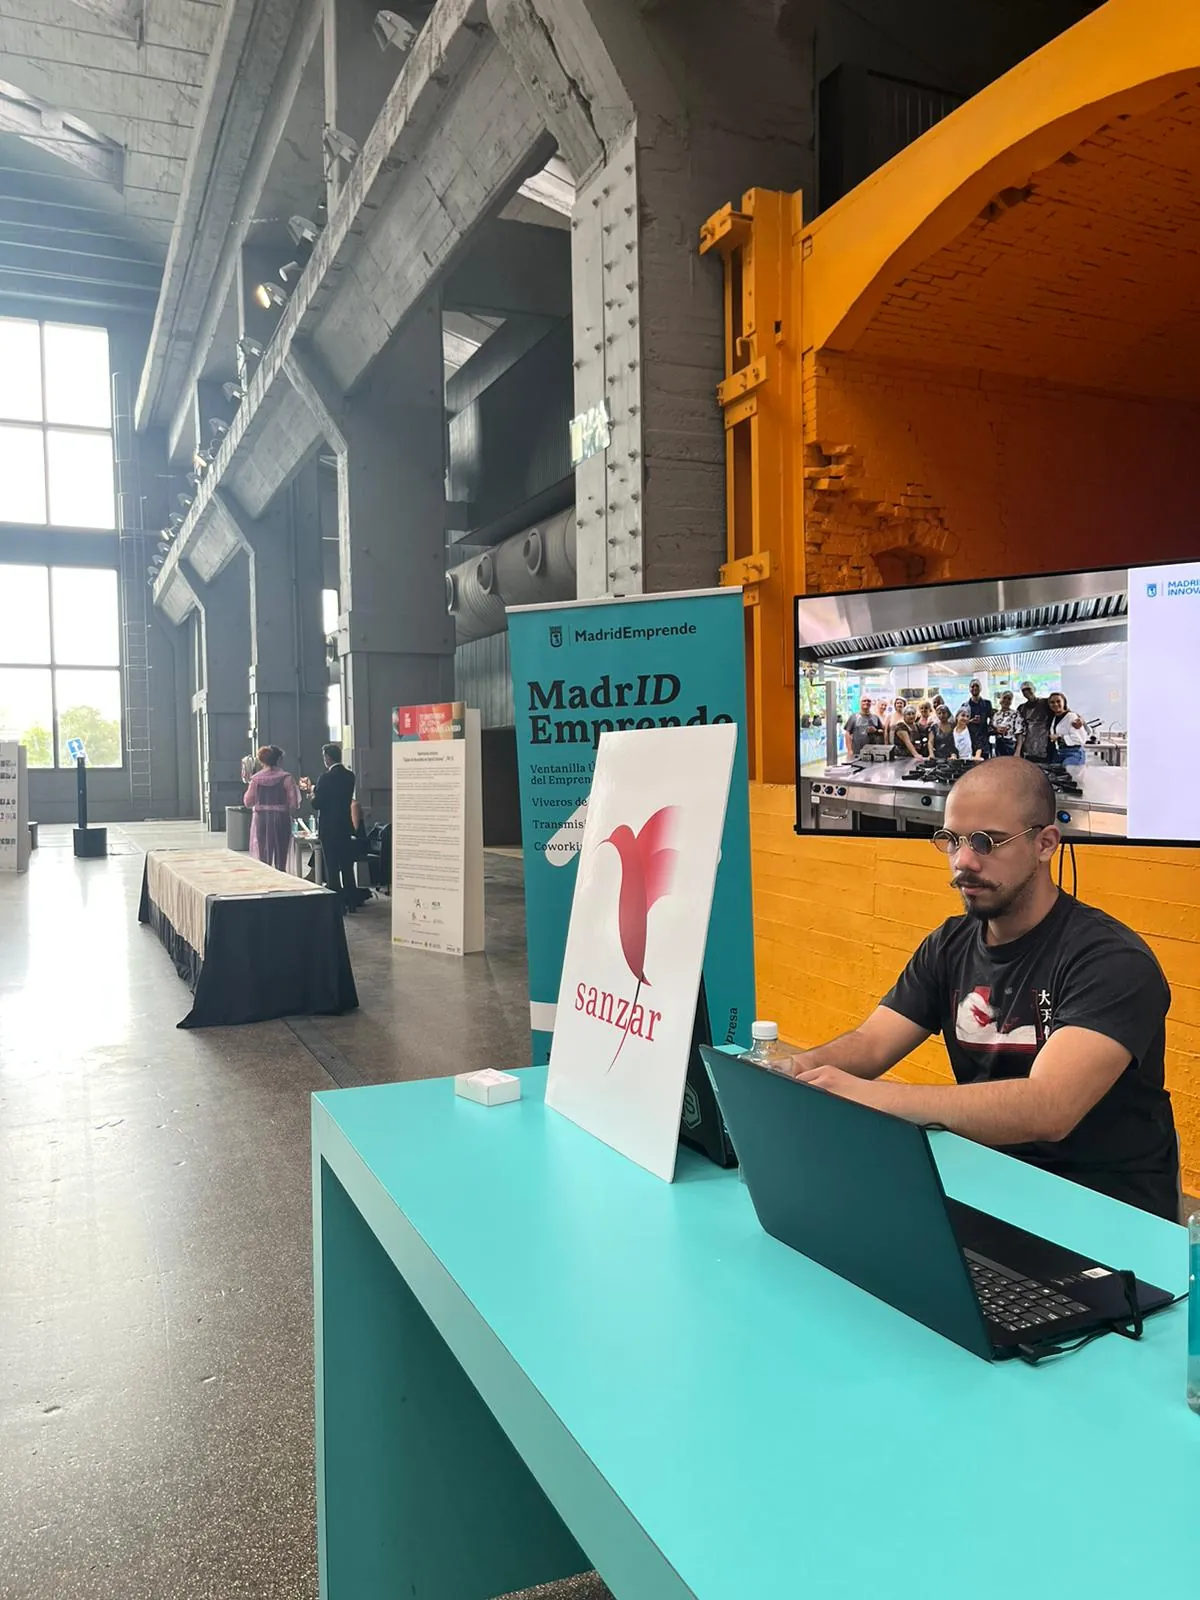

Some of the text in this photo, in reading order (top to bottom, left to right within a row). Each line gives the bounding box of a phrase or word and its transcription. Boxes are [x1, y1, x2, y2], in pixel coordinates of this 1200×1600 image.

[575, 622, 697, 643] MadridEmprende
[527, 673, 681, 711] MadrID
[530, 763, 586, 774] Ventanilla
[531, 775, 547, 785] del
[532, 796, 588, 807] Viveros de
[575, 982, 662, 1042] sanzar
[724, 1007, 738, 1045] presa
